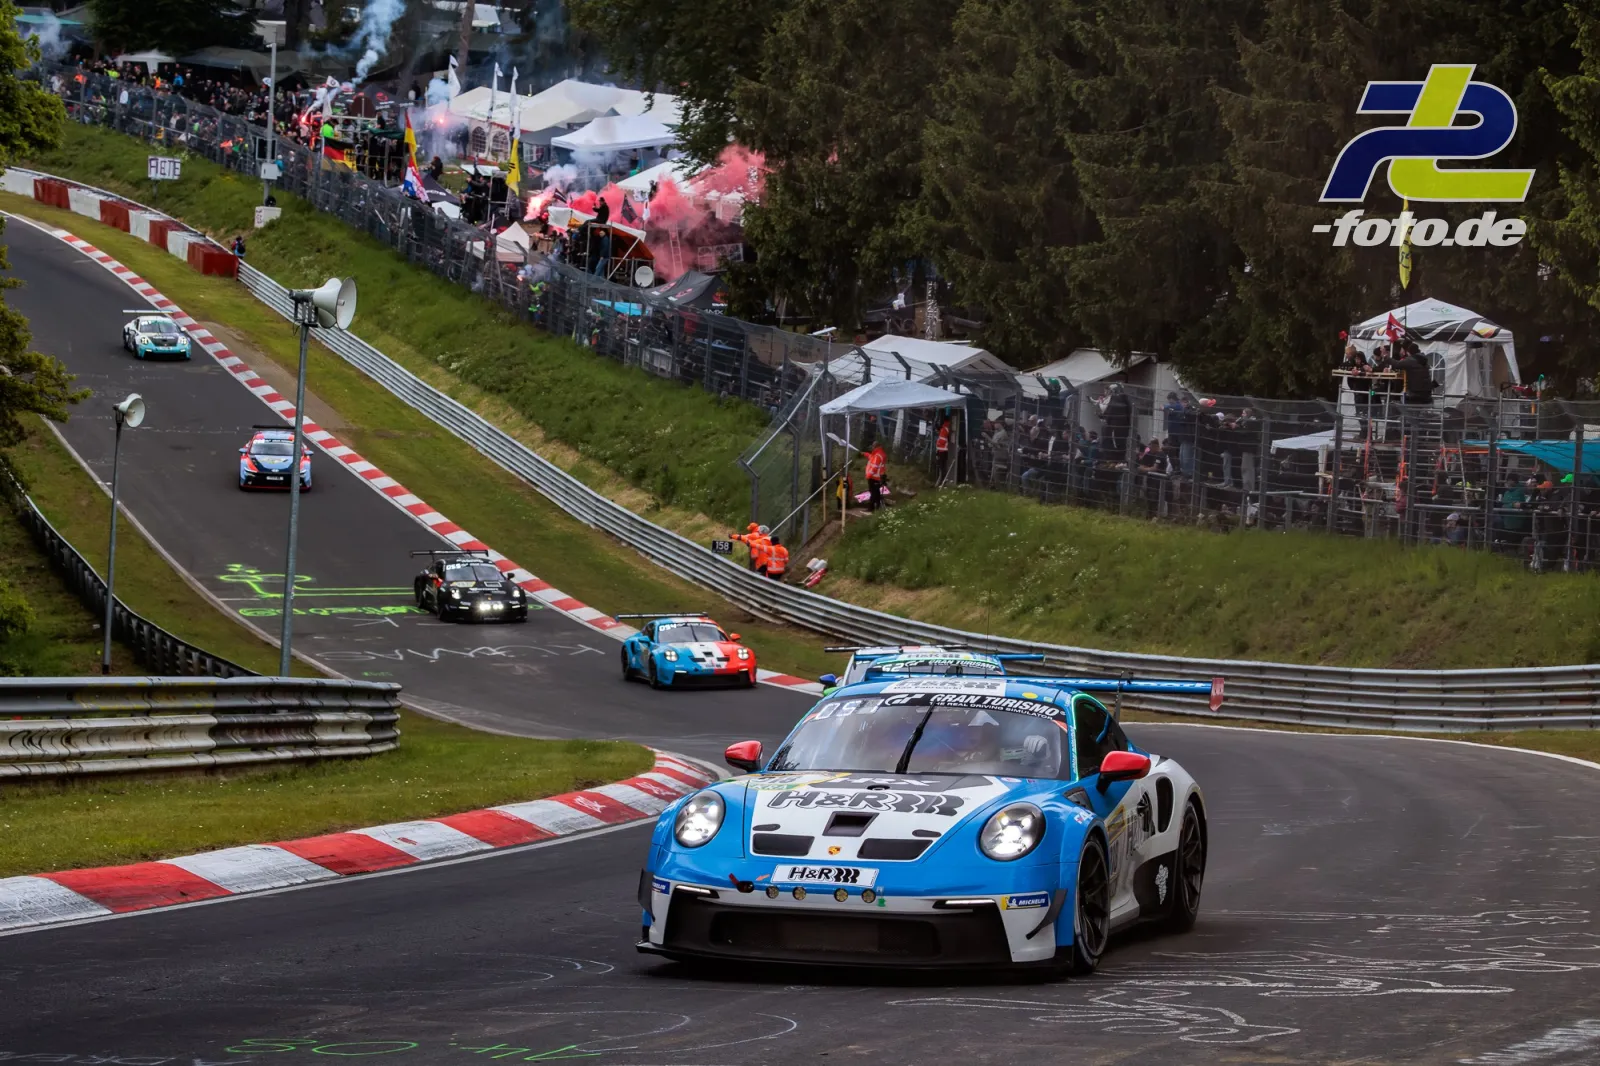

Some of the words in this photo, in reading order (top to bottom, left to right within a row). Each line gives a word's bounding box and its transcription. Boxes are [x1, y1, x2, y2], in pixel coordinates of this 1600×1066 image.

[716, 541, 730, 550] 158
[930, 694, 983, 705] GRAN
[983, 696, 1060, 717] TURISMO
[1005, 707, 1054, 720] SIMULATOR
[788, 866, 835, 882] H&R
